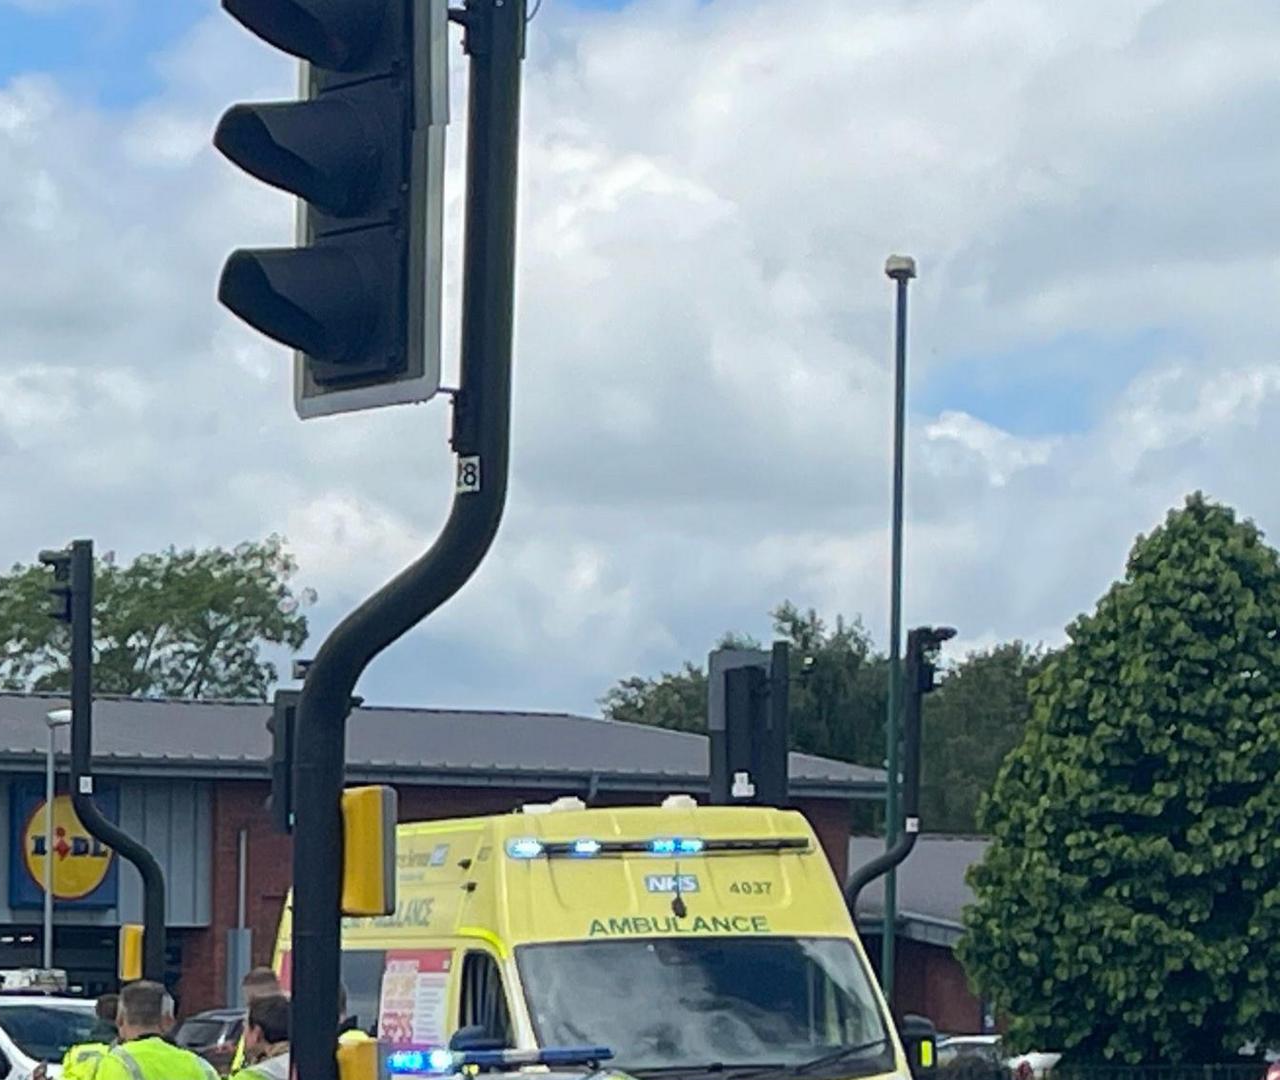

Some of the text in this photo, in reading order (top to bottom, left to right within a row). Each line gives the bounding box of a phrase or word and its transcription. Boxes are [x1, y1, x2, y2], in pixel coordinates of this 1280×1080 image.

[647, 876, 697, 893] NHS
[729, 881, 772, 895] 4037
[589, 915, 771, 937] AMBULANCE
